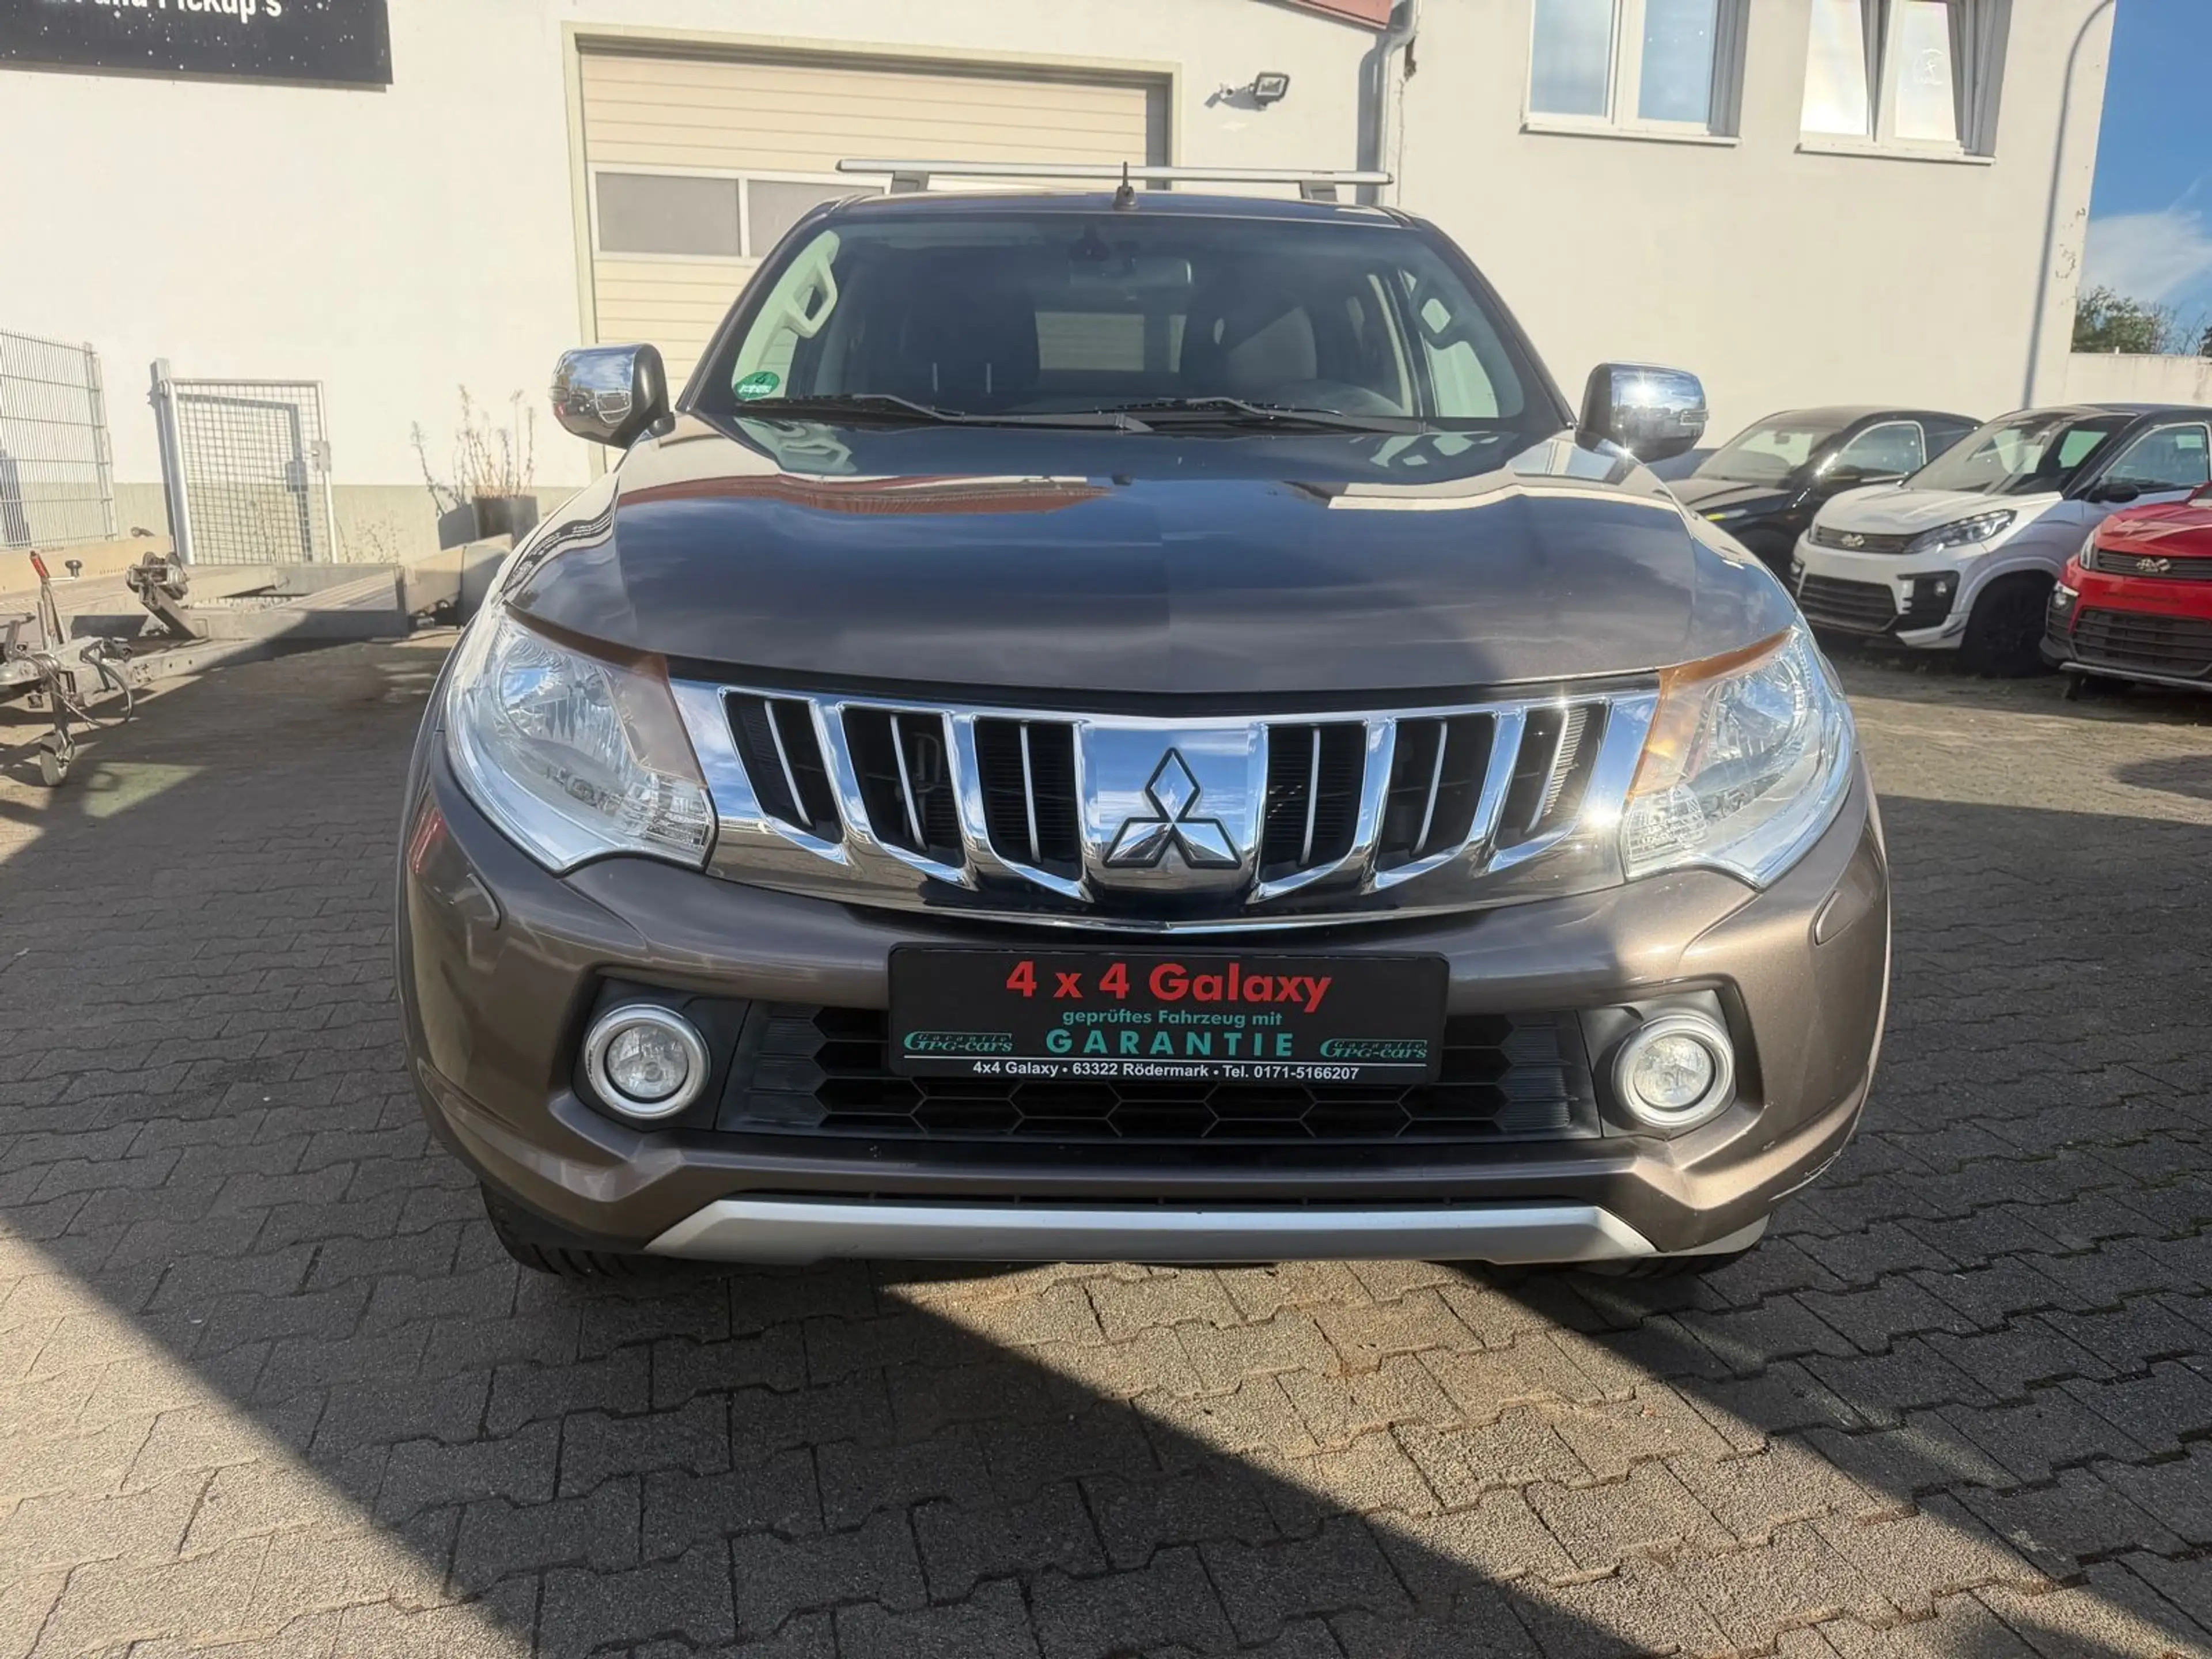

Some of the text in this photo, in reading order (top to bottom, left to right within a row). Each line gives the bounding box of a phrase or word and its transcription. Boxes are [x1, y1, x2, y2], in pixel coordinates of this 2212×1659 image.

[1006, 961, 1332, 1013] 4 x 4 Galaxy
[1062, 1009, 1283, 1028] geprüftes Fahrzeug mit
[1046, 1029, 1294, 1056] GARANTIE
[973, 1062, 1359, 1080] 4x4 Galaxy 63322 Rödermark Tel. 0171-5166207
